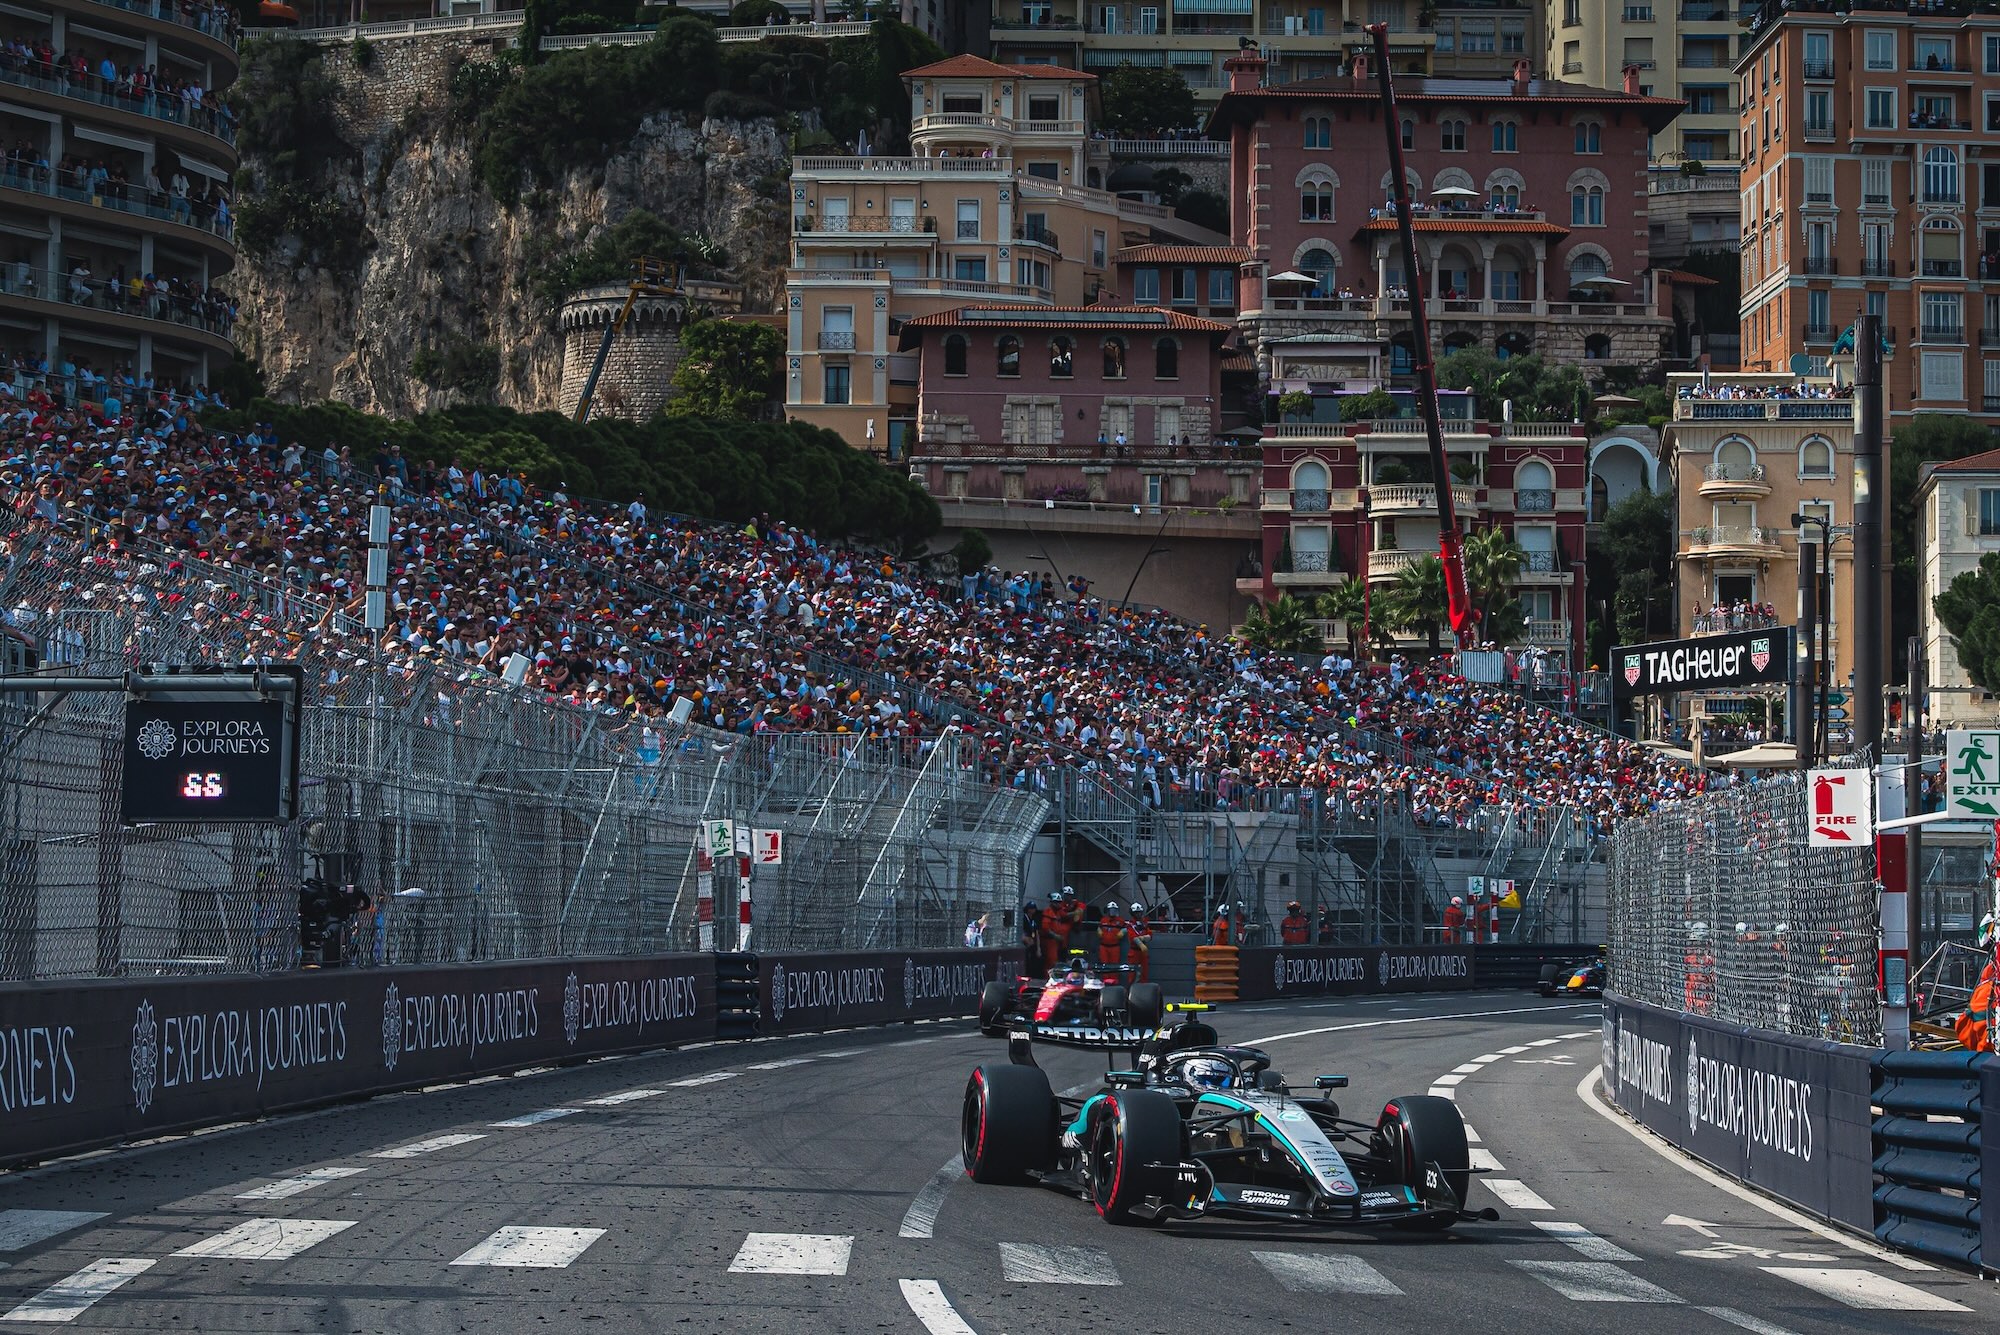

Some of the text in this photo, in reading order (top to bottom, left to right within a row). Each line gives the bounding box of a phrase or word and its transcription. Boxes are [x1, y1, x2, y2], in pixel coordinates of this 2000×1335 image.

[1752, 640, 1768, 653] TAG
[1626, 656, 1639, 668] TAG
[184, 721, 264, 736] EXPLORA
[180, 738, 270, 757] JOURNEYS
[1953, 786, 2000, 795] EXIT
[1816, 816, 1857, 825] FIRE
[1286, 957, 1364, 987] EXPLORA JOURNEYS
[1390, 955, 1467, 982] EXPLORA JOURNEYS
[788, 968, 885, 1015] EXPLORA JOURNEYS
[583, 976, 696, 1036] EXPLORA JOURNEYS
[405, 988, 539, 1060] EXPLORA JOURNEYS
[164, 1001, 347, 1092] EXPLORA JOURNEYS
[1700, 1057, 1812, 1162] EXPLORA JOURNEYS
[1426, 1169, 1437, 1188] EOS
[1238, 1194, 1289, 1206] Syntium
[1241, 1190, 1290, 1200] PETRONAS
